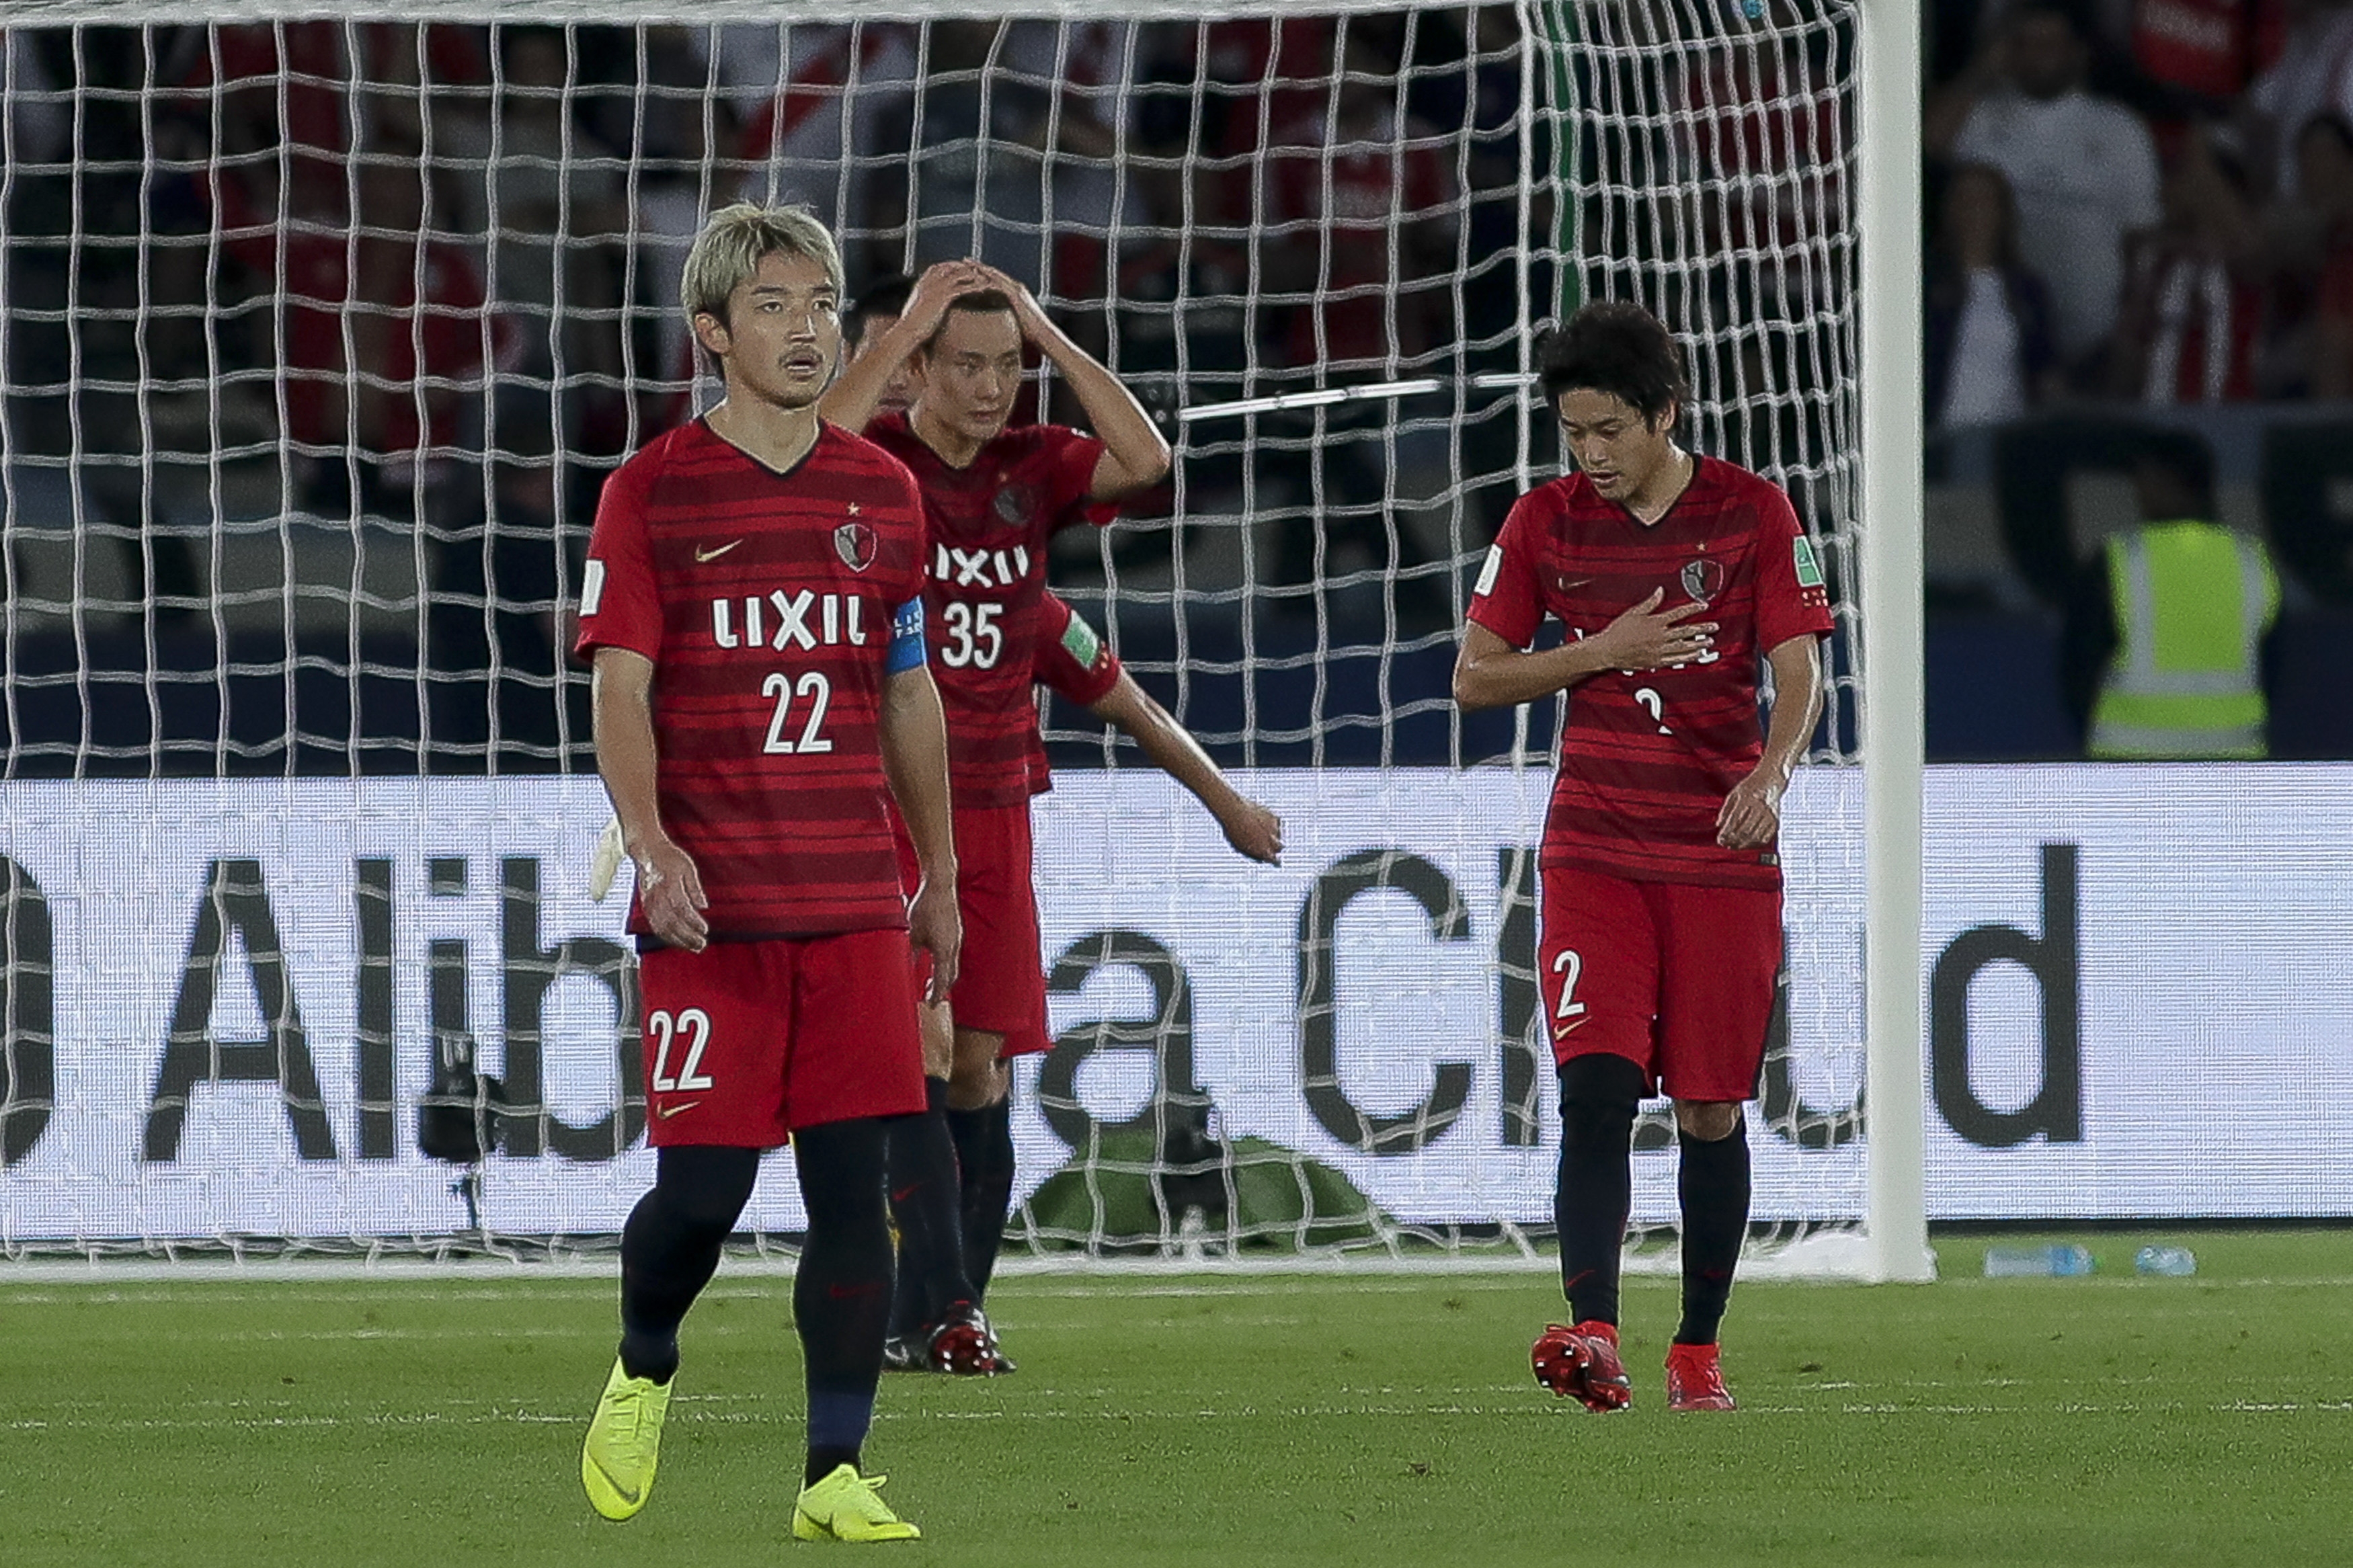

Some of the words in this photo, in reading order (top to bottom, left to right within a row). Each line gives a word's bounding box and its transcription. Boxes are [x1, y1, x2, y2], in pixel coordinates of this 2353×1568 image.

[924, 542, 1029, 588] IXI
[713, 589, 867, 651] LIXIL
[941, 602, 1003, 669] 35
[761, 671, 833, 753] 22
[141, 857, 1194, 1163] Aliba
[1298, 843, 2080, 1153] Cld
[1553, 950, 1585, 1018] 2
[649, 1008, 713, 1091] 22
